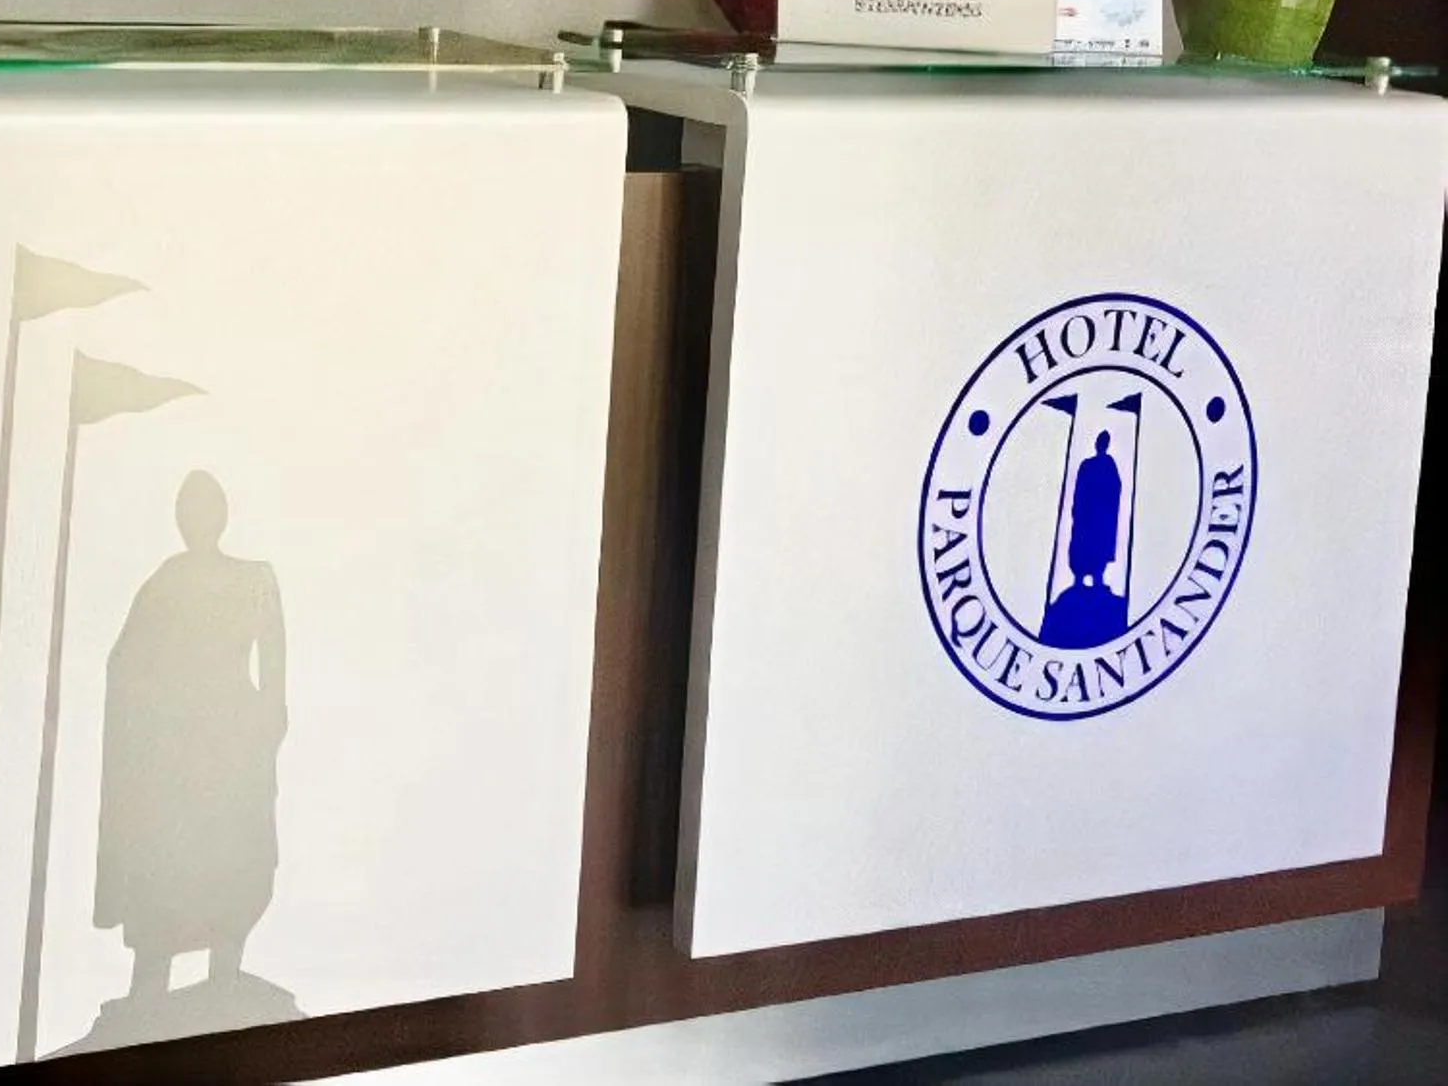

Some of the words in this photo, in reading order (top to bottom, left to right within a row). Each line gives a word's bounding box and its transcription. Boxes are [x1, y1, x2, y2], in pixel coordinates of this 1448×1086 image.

[1013, 308, 1187, 384] HOTEL
[931, 487, 1033, 693] PARQUE
[1035, 463, 1246, 704] SANTANDER
